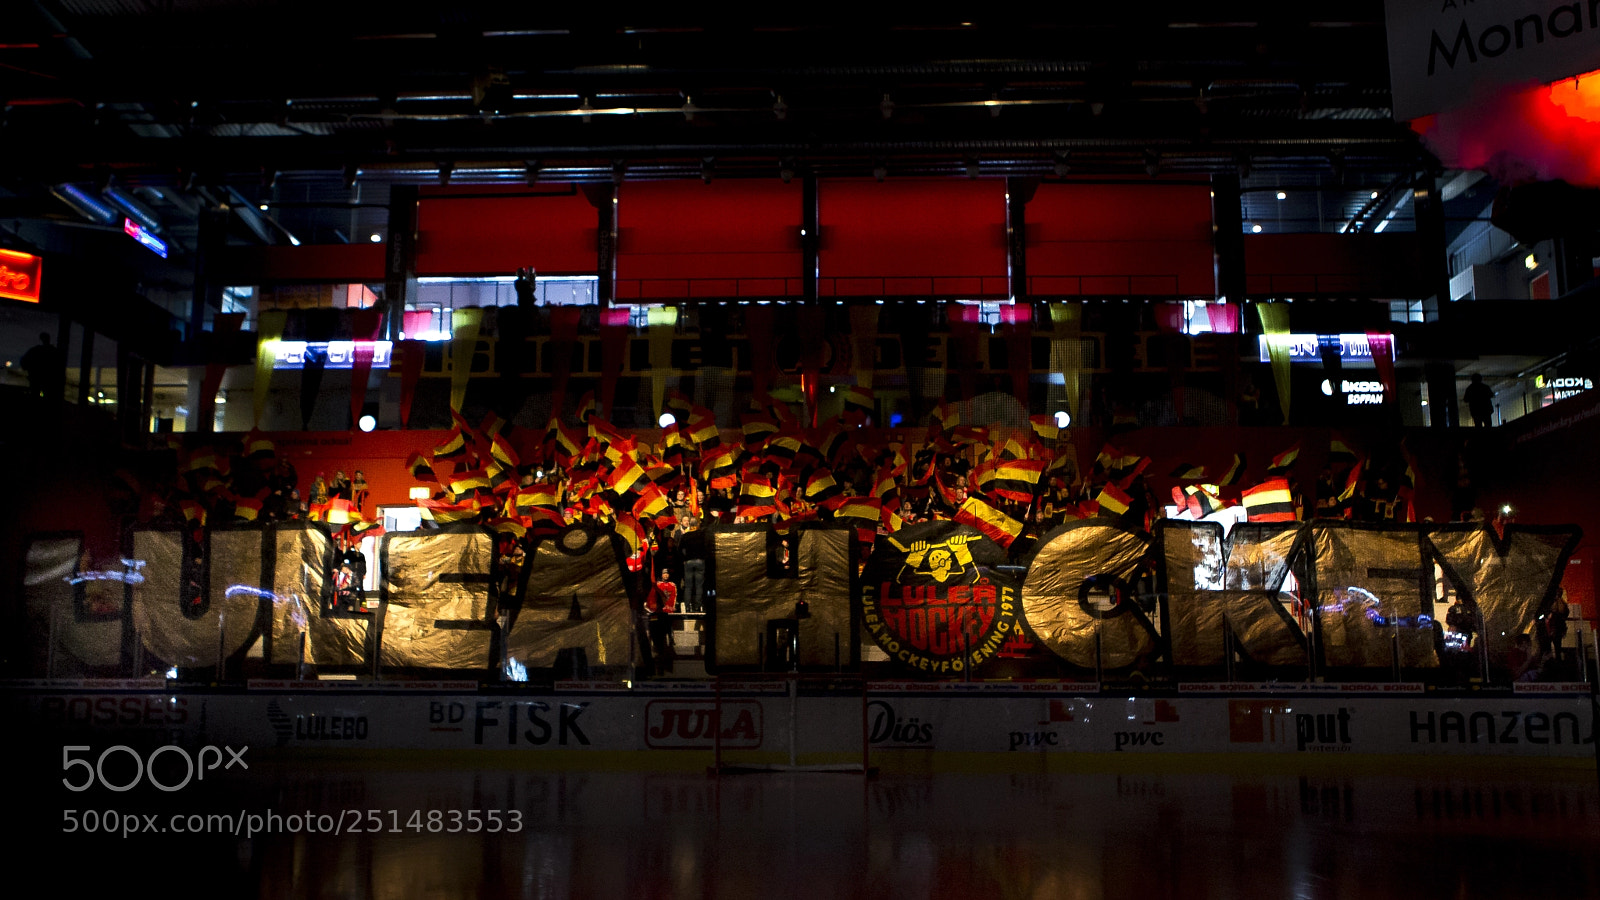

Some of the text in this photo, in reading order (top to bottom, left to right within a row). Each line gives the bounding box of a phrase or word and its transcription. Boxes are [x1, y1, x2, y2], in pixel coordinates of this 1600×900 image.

[880, 576, 997, 606] LULEÅ
[1001, 586, 1015, 618] 1977
[881, 605, 996, 656] HOCKEY
[296, 716, 368, 740] LULEBO
[429, 701, 592, 746] BD FISK
[650, 708, 757, 740] JULA
[867, 700, 934, 744] Diös
[1295, 707, 1352, 752] put
[1009, 730, 1059, 751] pwc
[1114, 730, 1165, 751] pwc
